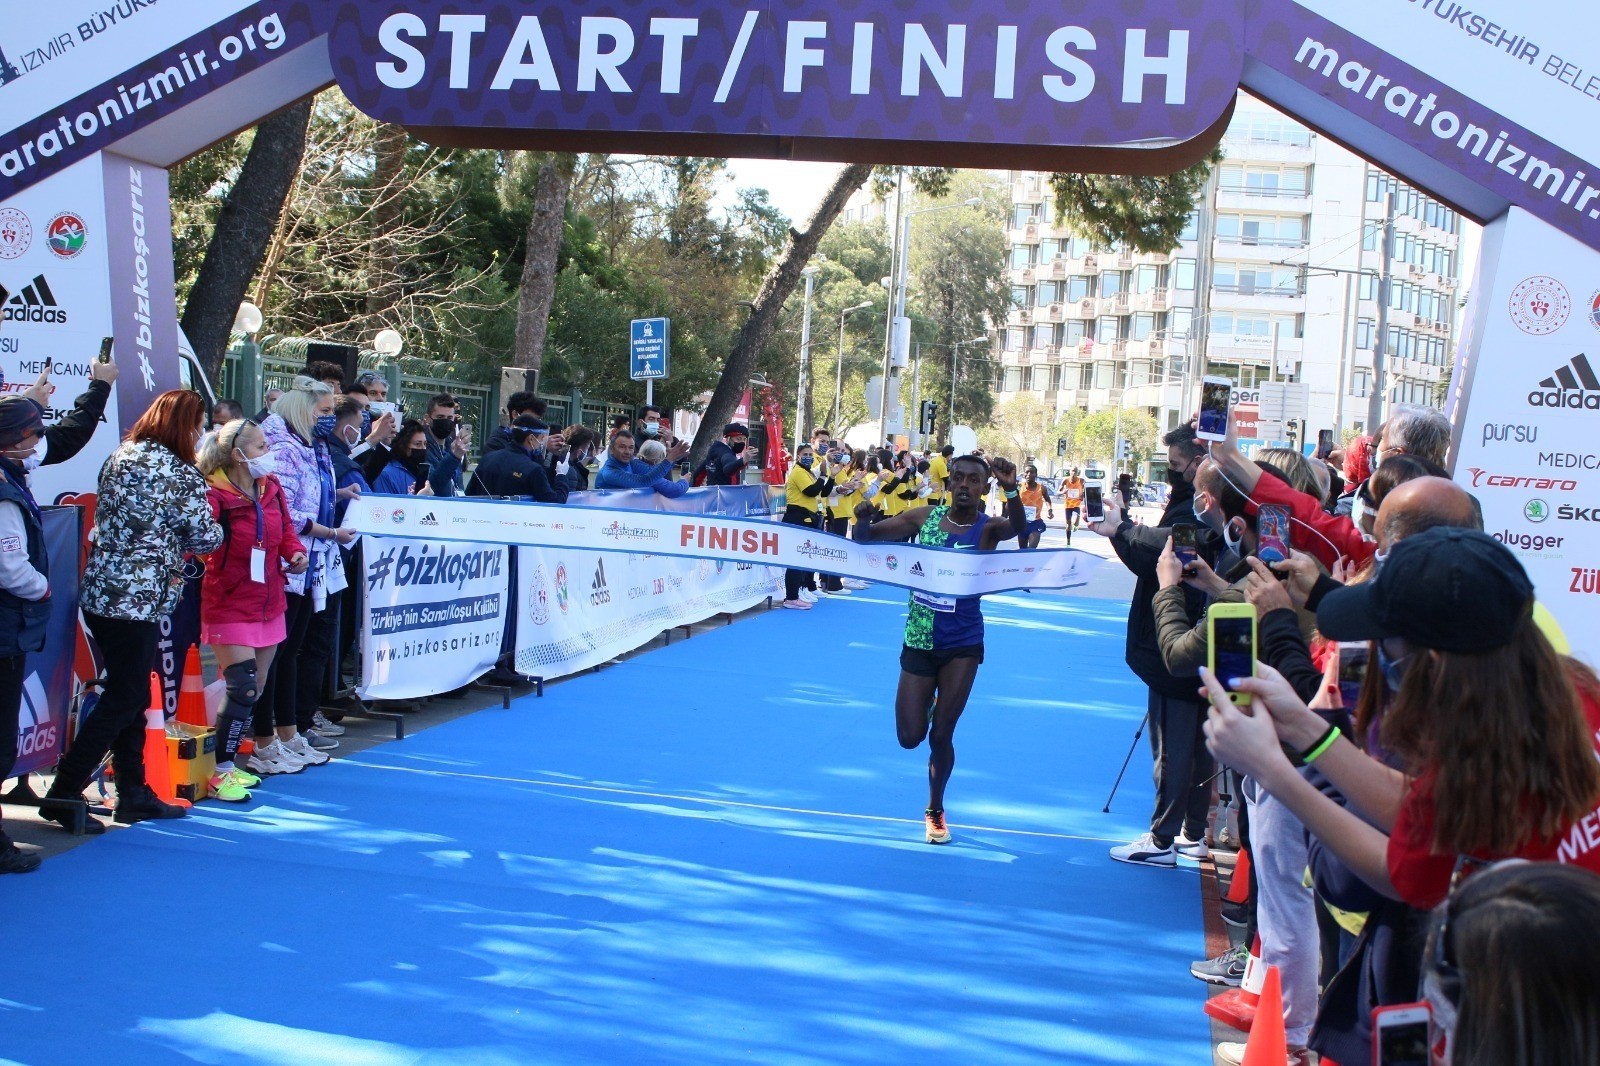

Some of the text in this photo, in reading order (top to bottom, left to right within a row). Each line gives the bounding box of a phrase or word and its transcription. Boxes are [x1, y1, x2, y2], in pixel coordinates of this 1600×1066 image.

[1541, 54, 1600, 101] BELE
[3, 304, 67, 324] adidas
[1482, 422, 1538, 448] pürsu
[1486, 474, 1578, 491] carraro
[680, 524, 779, 556] FINISH
[368, 543, 503, 592] #bizkoşarız
[1569, 567, 1600, 595] ZÜ
[372, 630, 500, 662] ww.bizkosariz.org
[158, 614, 178, 720] arato
[1556, 805, 1600, 865] ME
